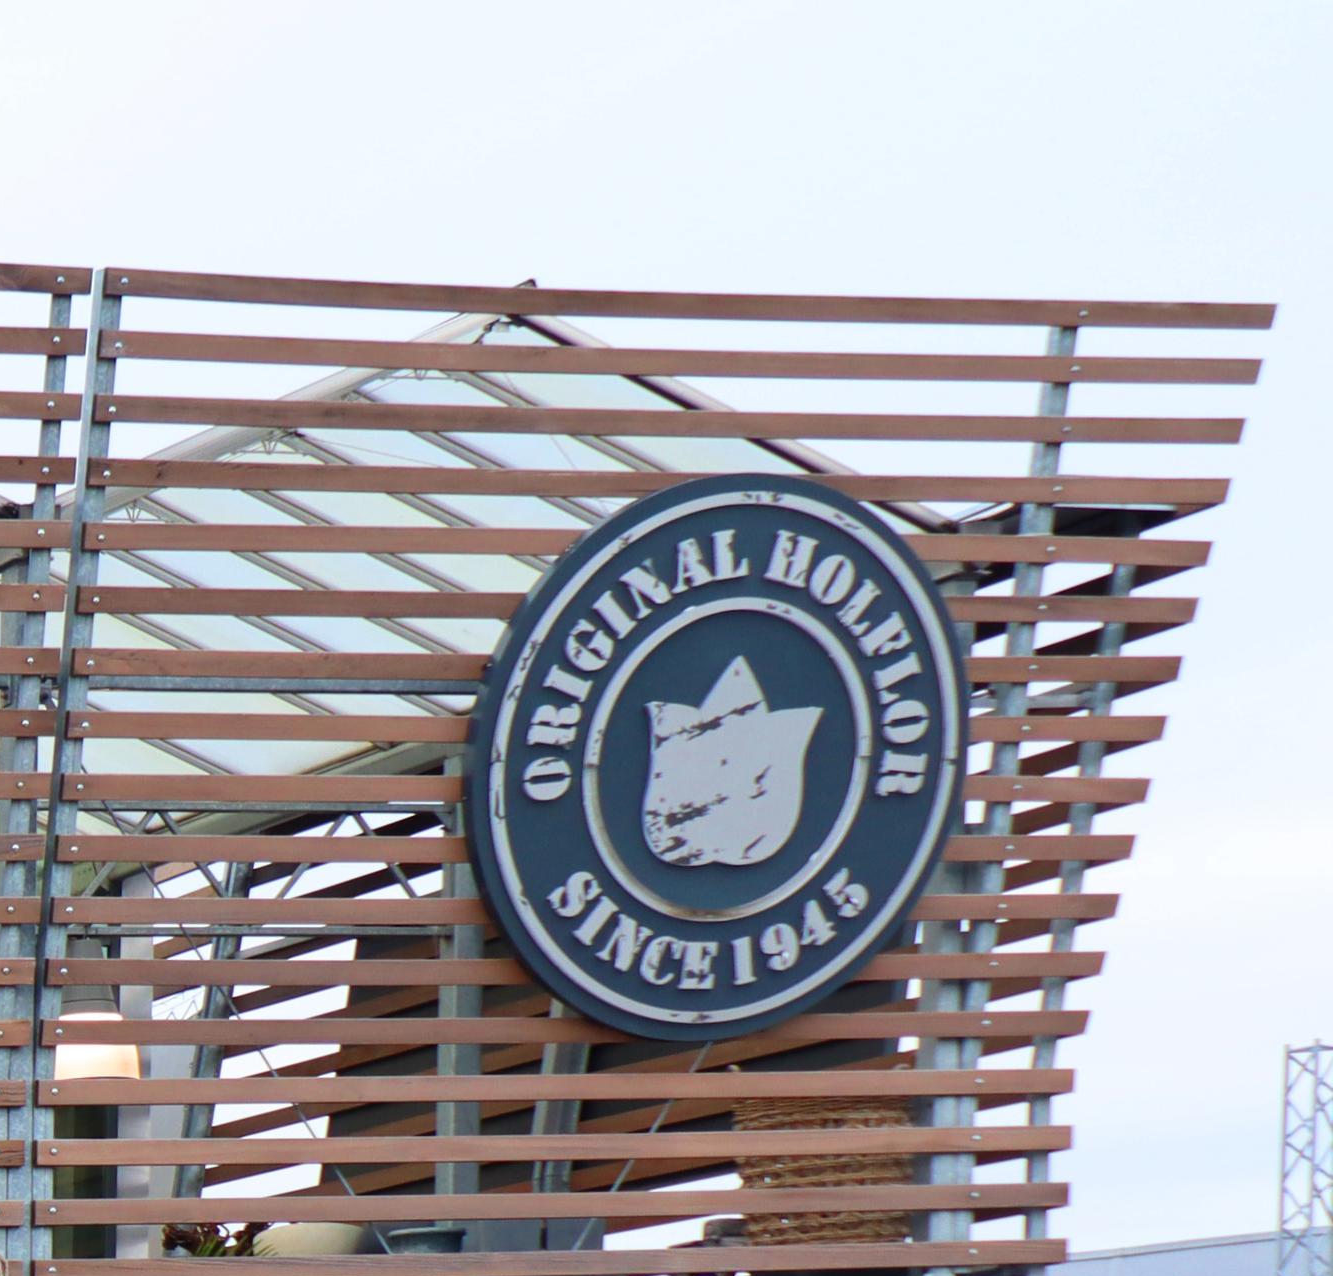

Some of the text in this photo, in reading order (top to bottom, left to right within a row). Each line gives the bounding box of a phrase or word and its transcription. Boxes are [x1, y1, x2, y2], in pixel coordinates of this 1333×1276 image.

[521, 528, 931, 802] ORIGINAL HOLFLOR
[546, 867, 870, 990] SINCE 1945
